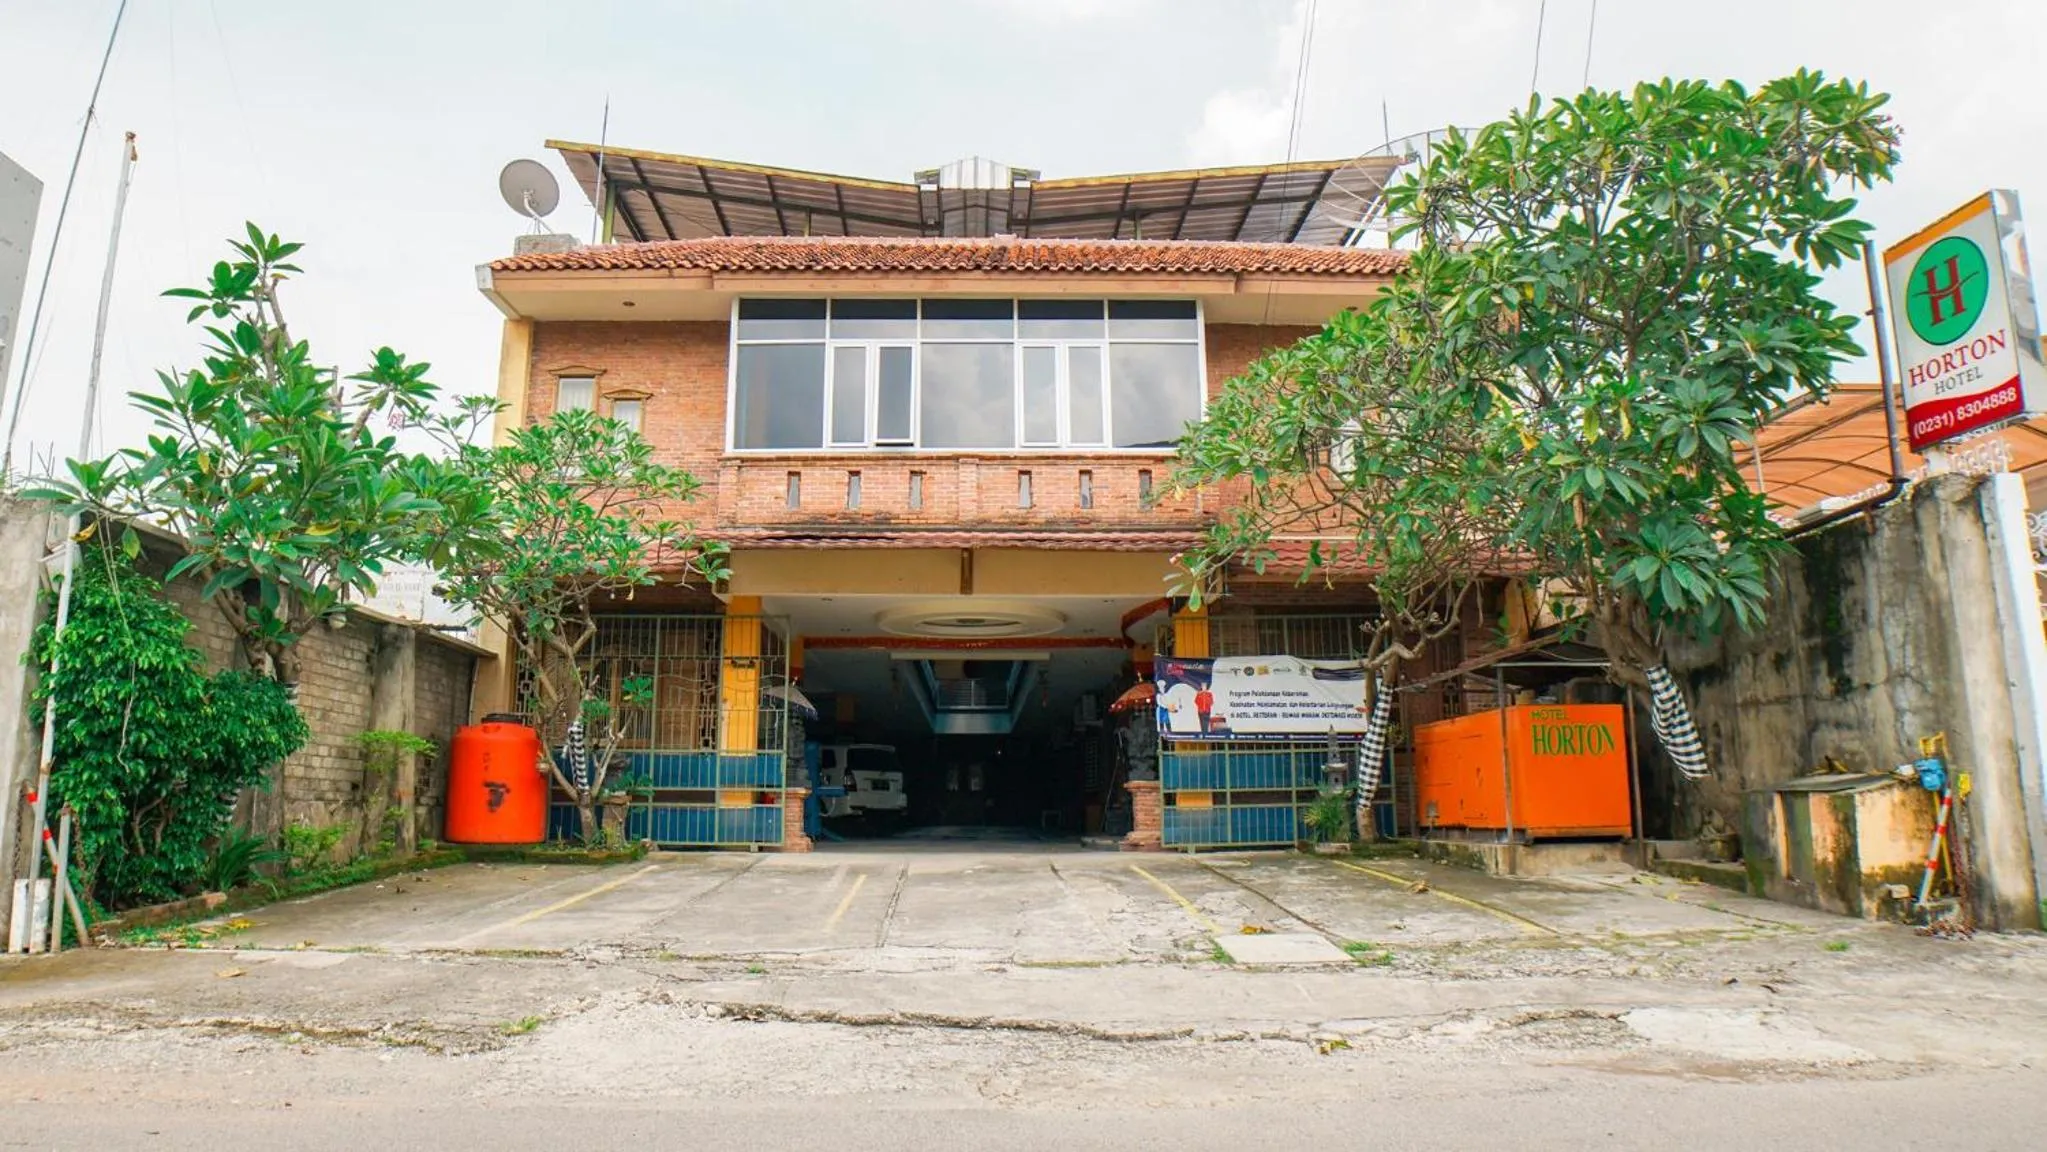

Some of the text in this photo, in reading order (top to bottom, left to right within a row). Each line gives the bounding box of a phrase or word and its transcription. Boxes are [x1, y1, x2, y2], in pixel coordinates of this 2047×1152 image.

[1908, 328, 2005, 388] HORTON
[1934, 366, 1983, 395] HOTEL
[1913, 387, 2017, 439] (0231) 8304888
[1530, 708, 1567, 720] HOTEL
[1532, 724, 1615, 755] HORTON
